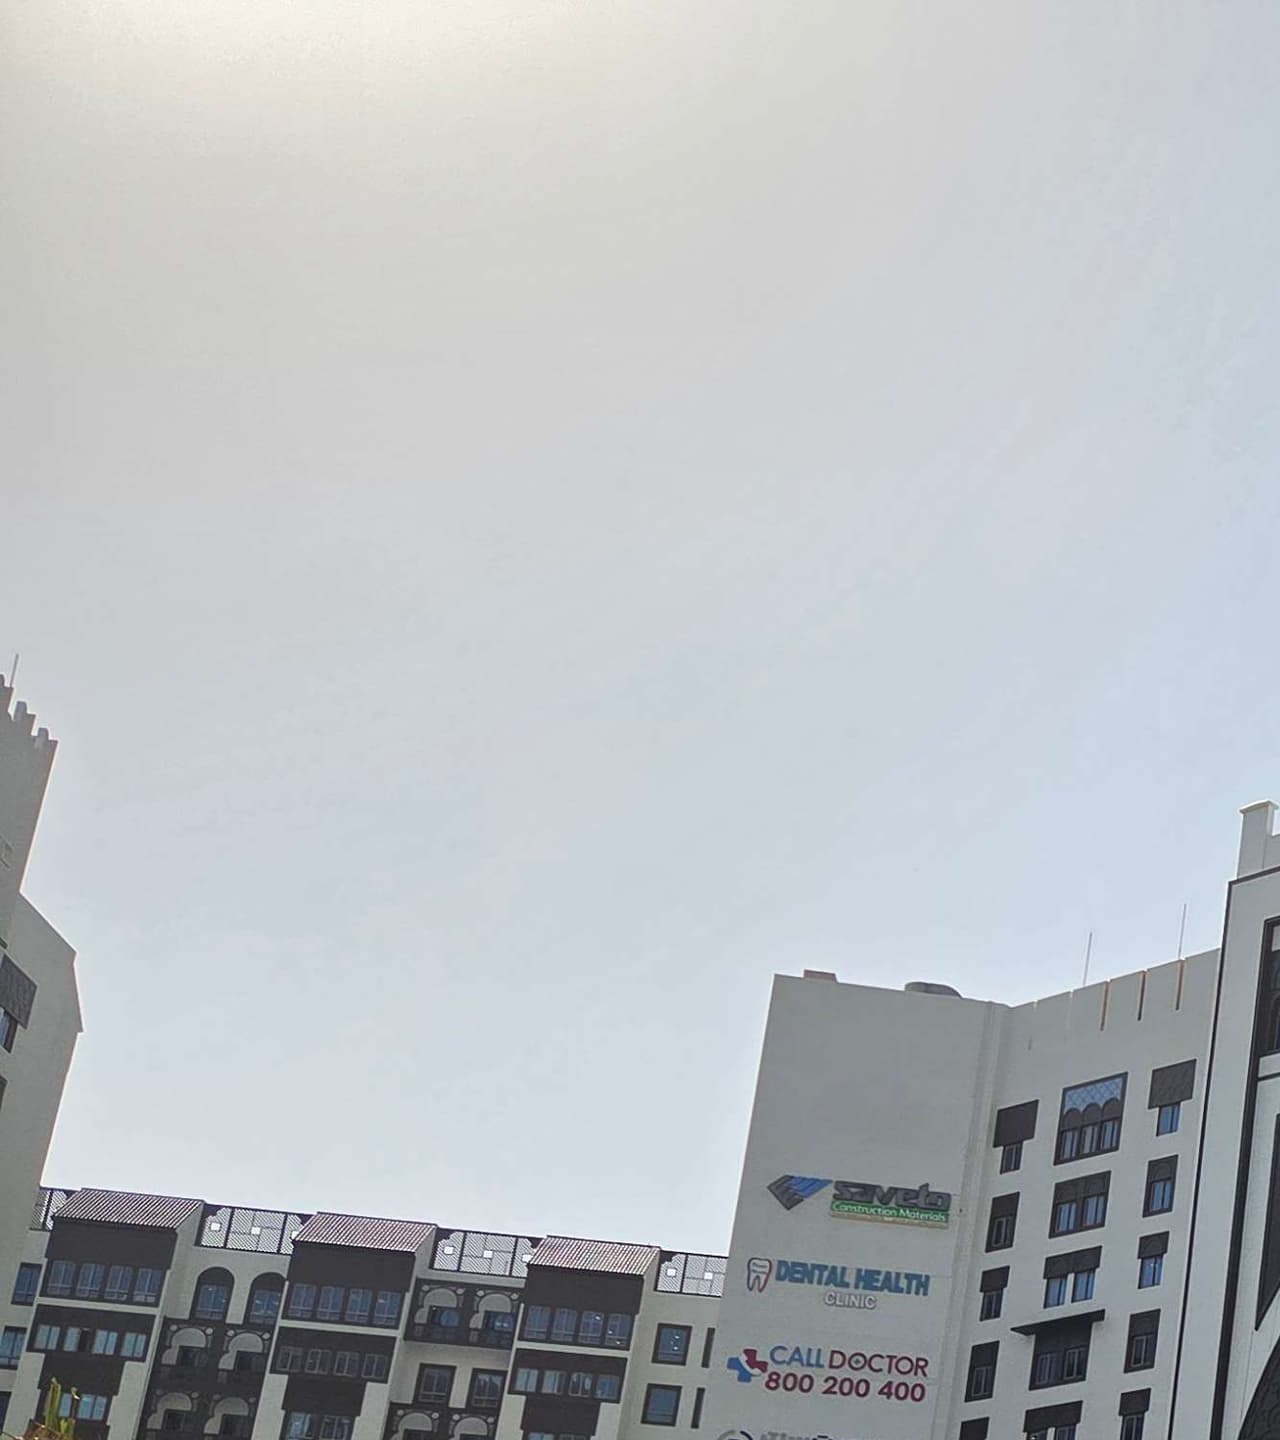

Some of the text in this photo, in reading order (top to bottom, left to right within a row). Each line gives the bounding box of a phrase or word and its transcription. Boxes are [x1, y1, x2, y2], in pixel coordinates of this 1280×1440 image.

[832, 1201, 946, 1222] Construction Materials
[775, 1260, 930, 1296] DENTAL HEALTH
[824, 1291, 877, 1310] CLINIC
[769, 1345, 929, 1377] CALL DOCTOR
[765, 1371, 926, 1402] 800 200 400
